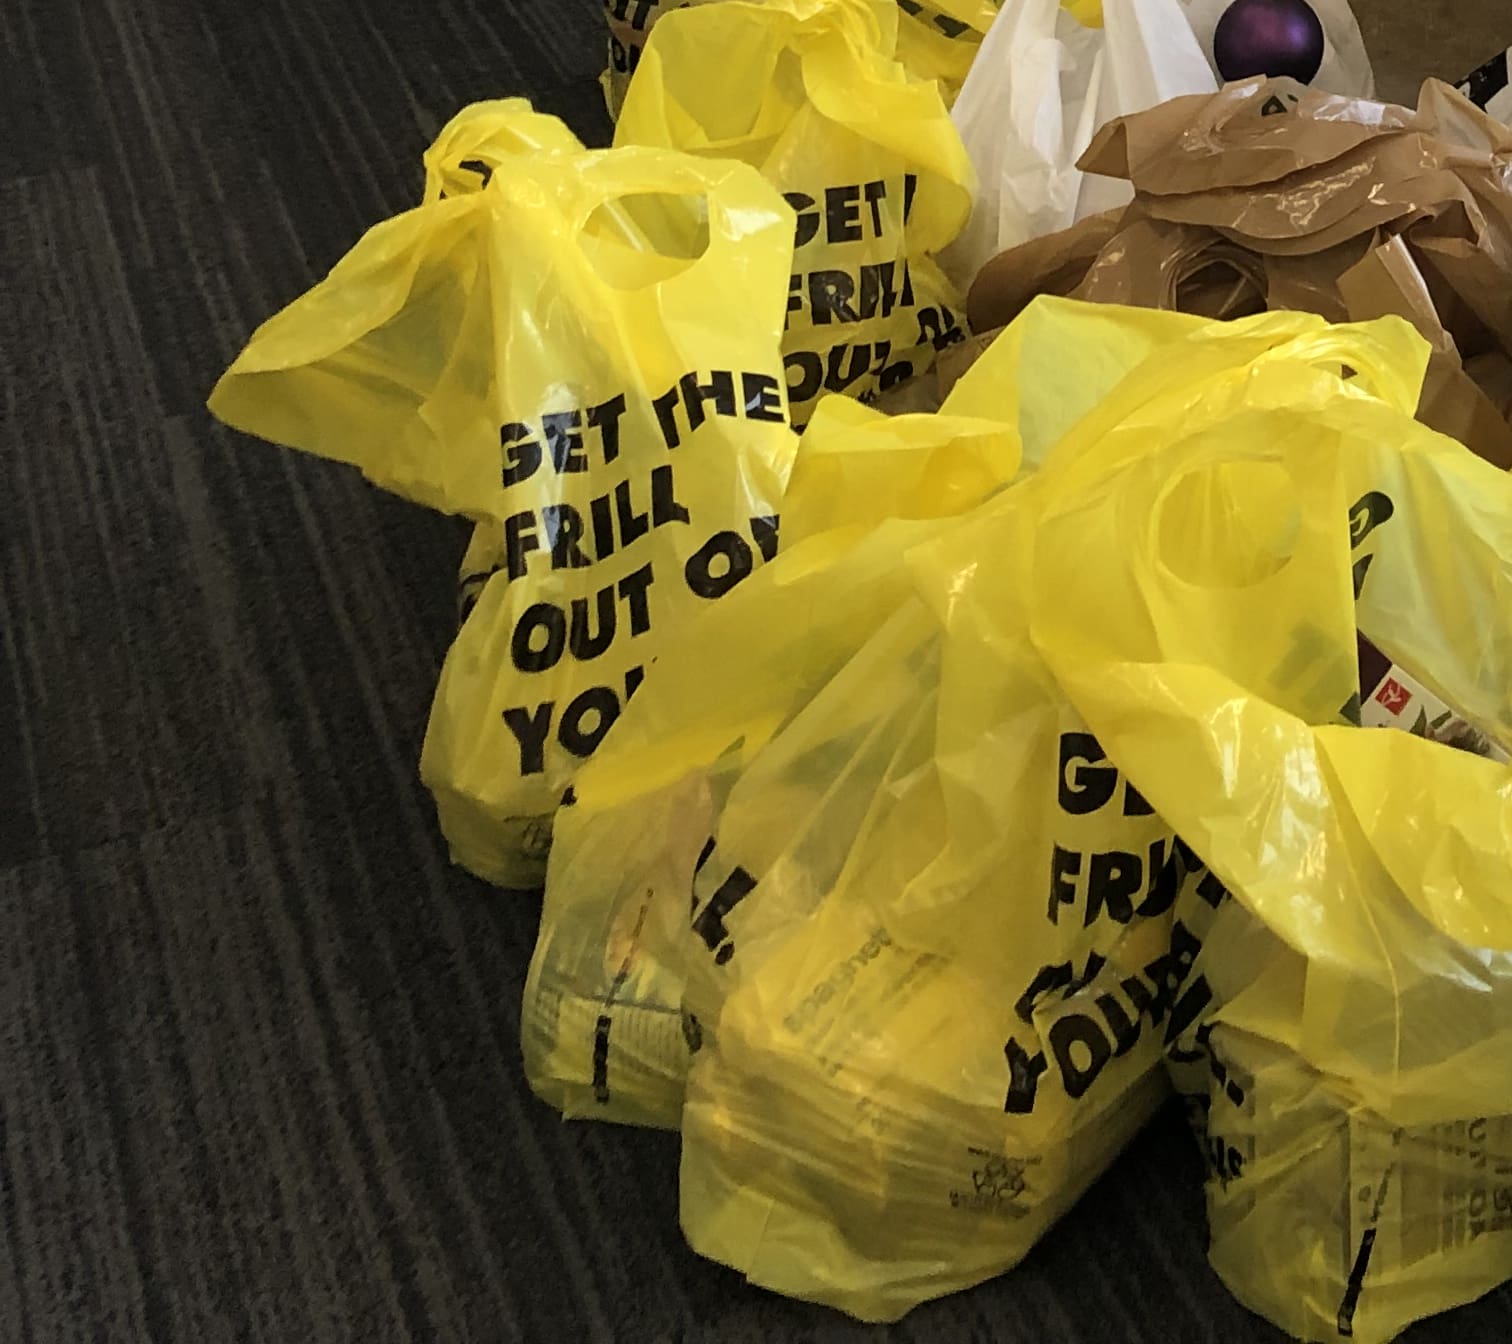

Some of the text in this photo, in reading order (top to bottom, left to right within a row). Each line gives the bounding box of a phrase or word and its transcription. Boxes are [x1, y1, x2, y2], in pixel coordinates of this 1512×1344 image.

[501, 393, 627, 488] GET
[651, 370, 787, 450] THE
[505, 464, 691, 582] FRILL
[511, 562, 655, 674] OUT
